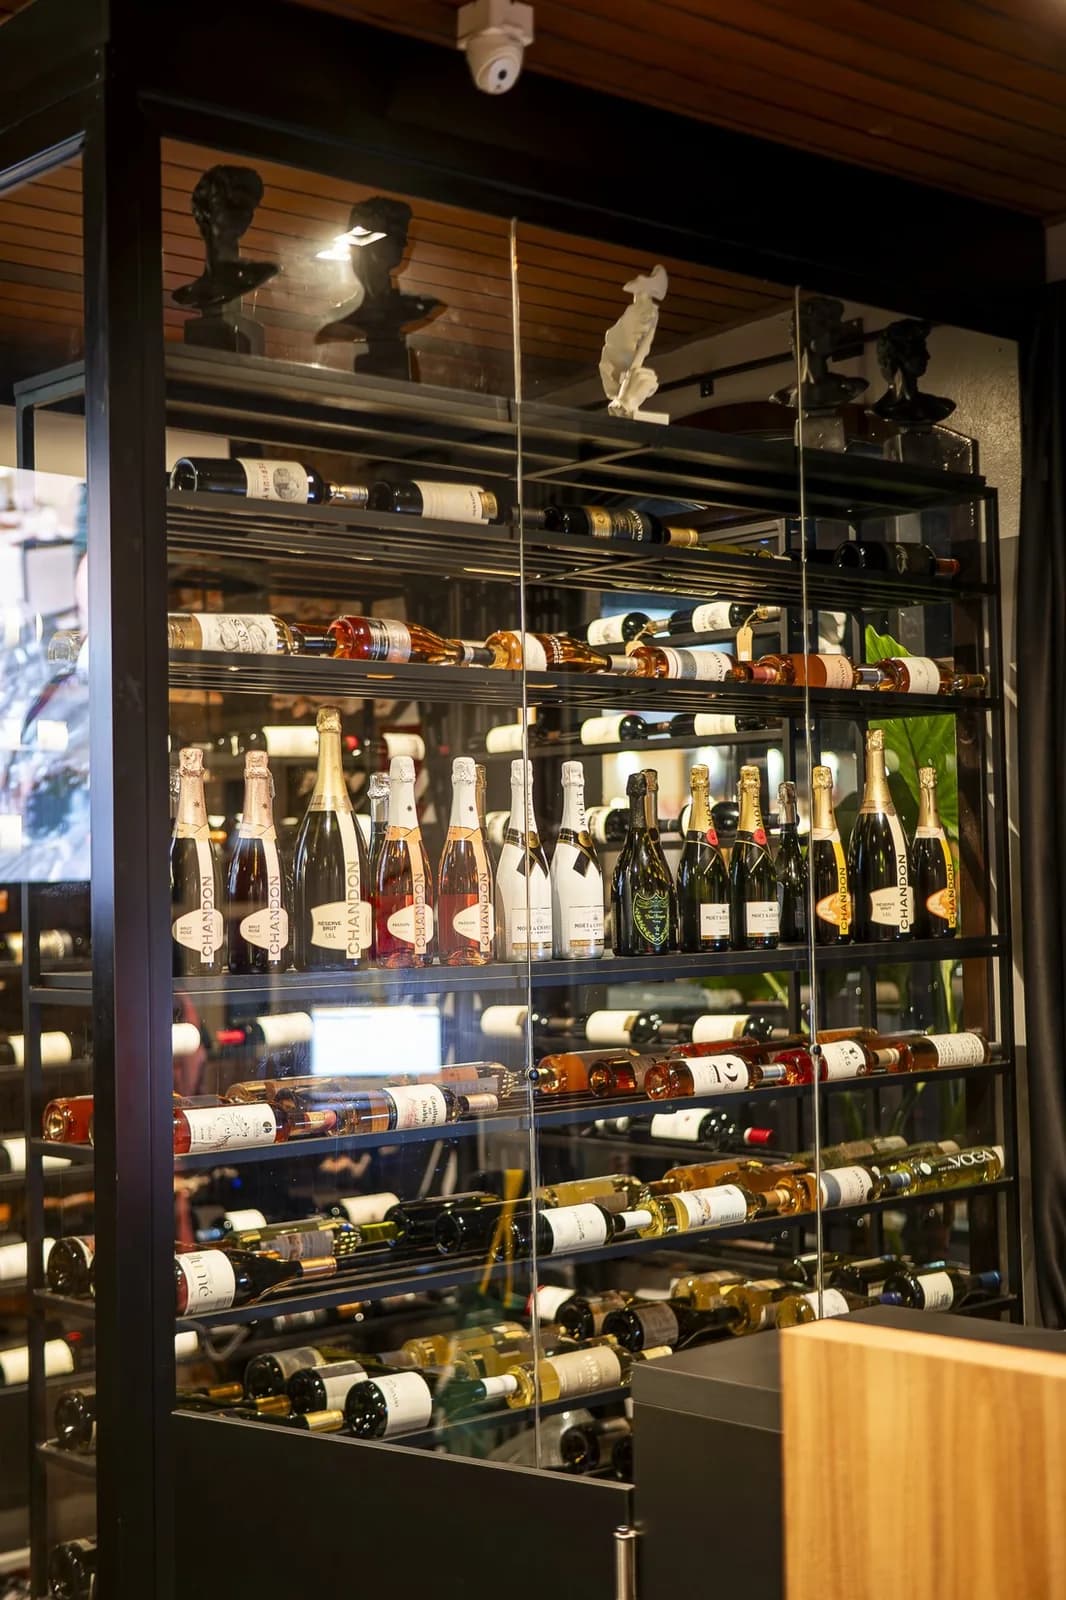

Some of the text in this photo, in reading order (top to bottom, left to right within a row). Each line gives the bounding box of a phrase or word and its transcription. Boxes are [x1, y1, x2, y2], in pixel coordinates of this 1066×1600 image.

[202, 875, 213, 957] CHANDON
[269, 875, 280, 955] CHANDON
[346, 861, 360, 955] CHANDON
[414, 872, 426, 947] CHANDON
[480, 872, 490, 946] CHANDON
[839, 867, 848, 930] CHANDON
[897, 854, 909, 930] CHANDON
[945, 863, 957, 925] CHANDON
[947, 1149, 995, 1168] YOGA
